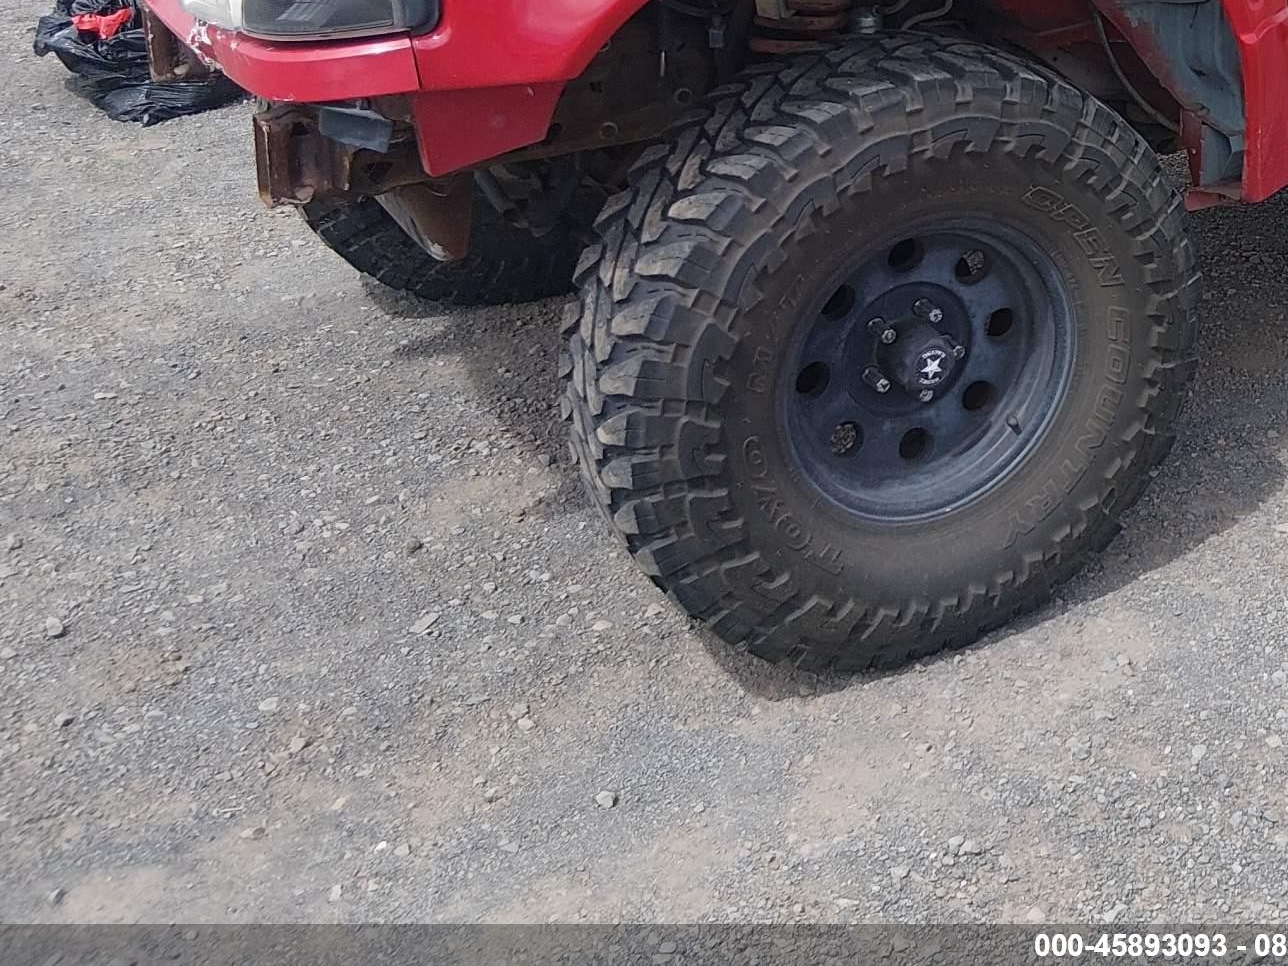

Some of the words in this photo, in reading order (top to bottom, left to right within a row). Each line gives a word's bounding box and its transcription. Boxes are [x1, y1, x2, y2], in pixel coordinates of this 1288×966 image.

[1021, 184, 1124, 289] OPEN
[1004, 306, 1133, 548] COUNTRY
[742, 434, 847, 577] TOYO
